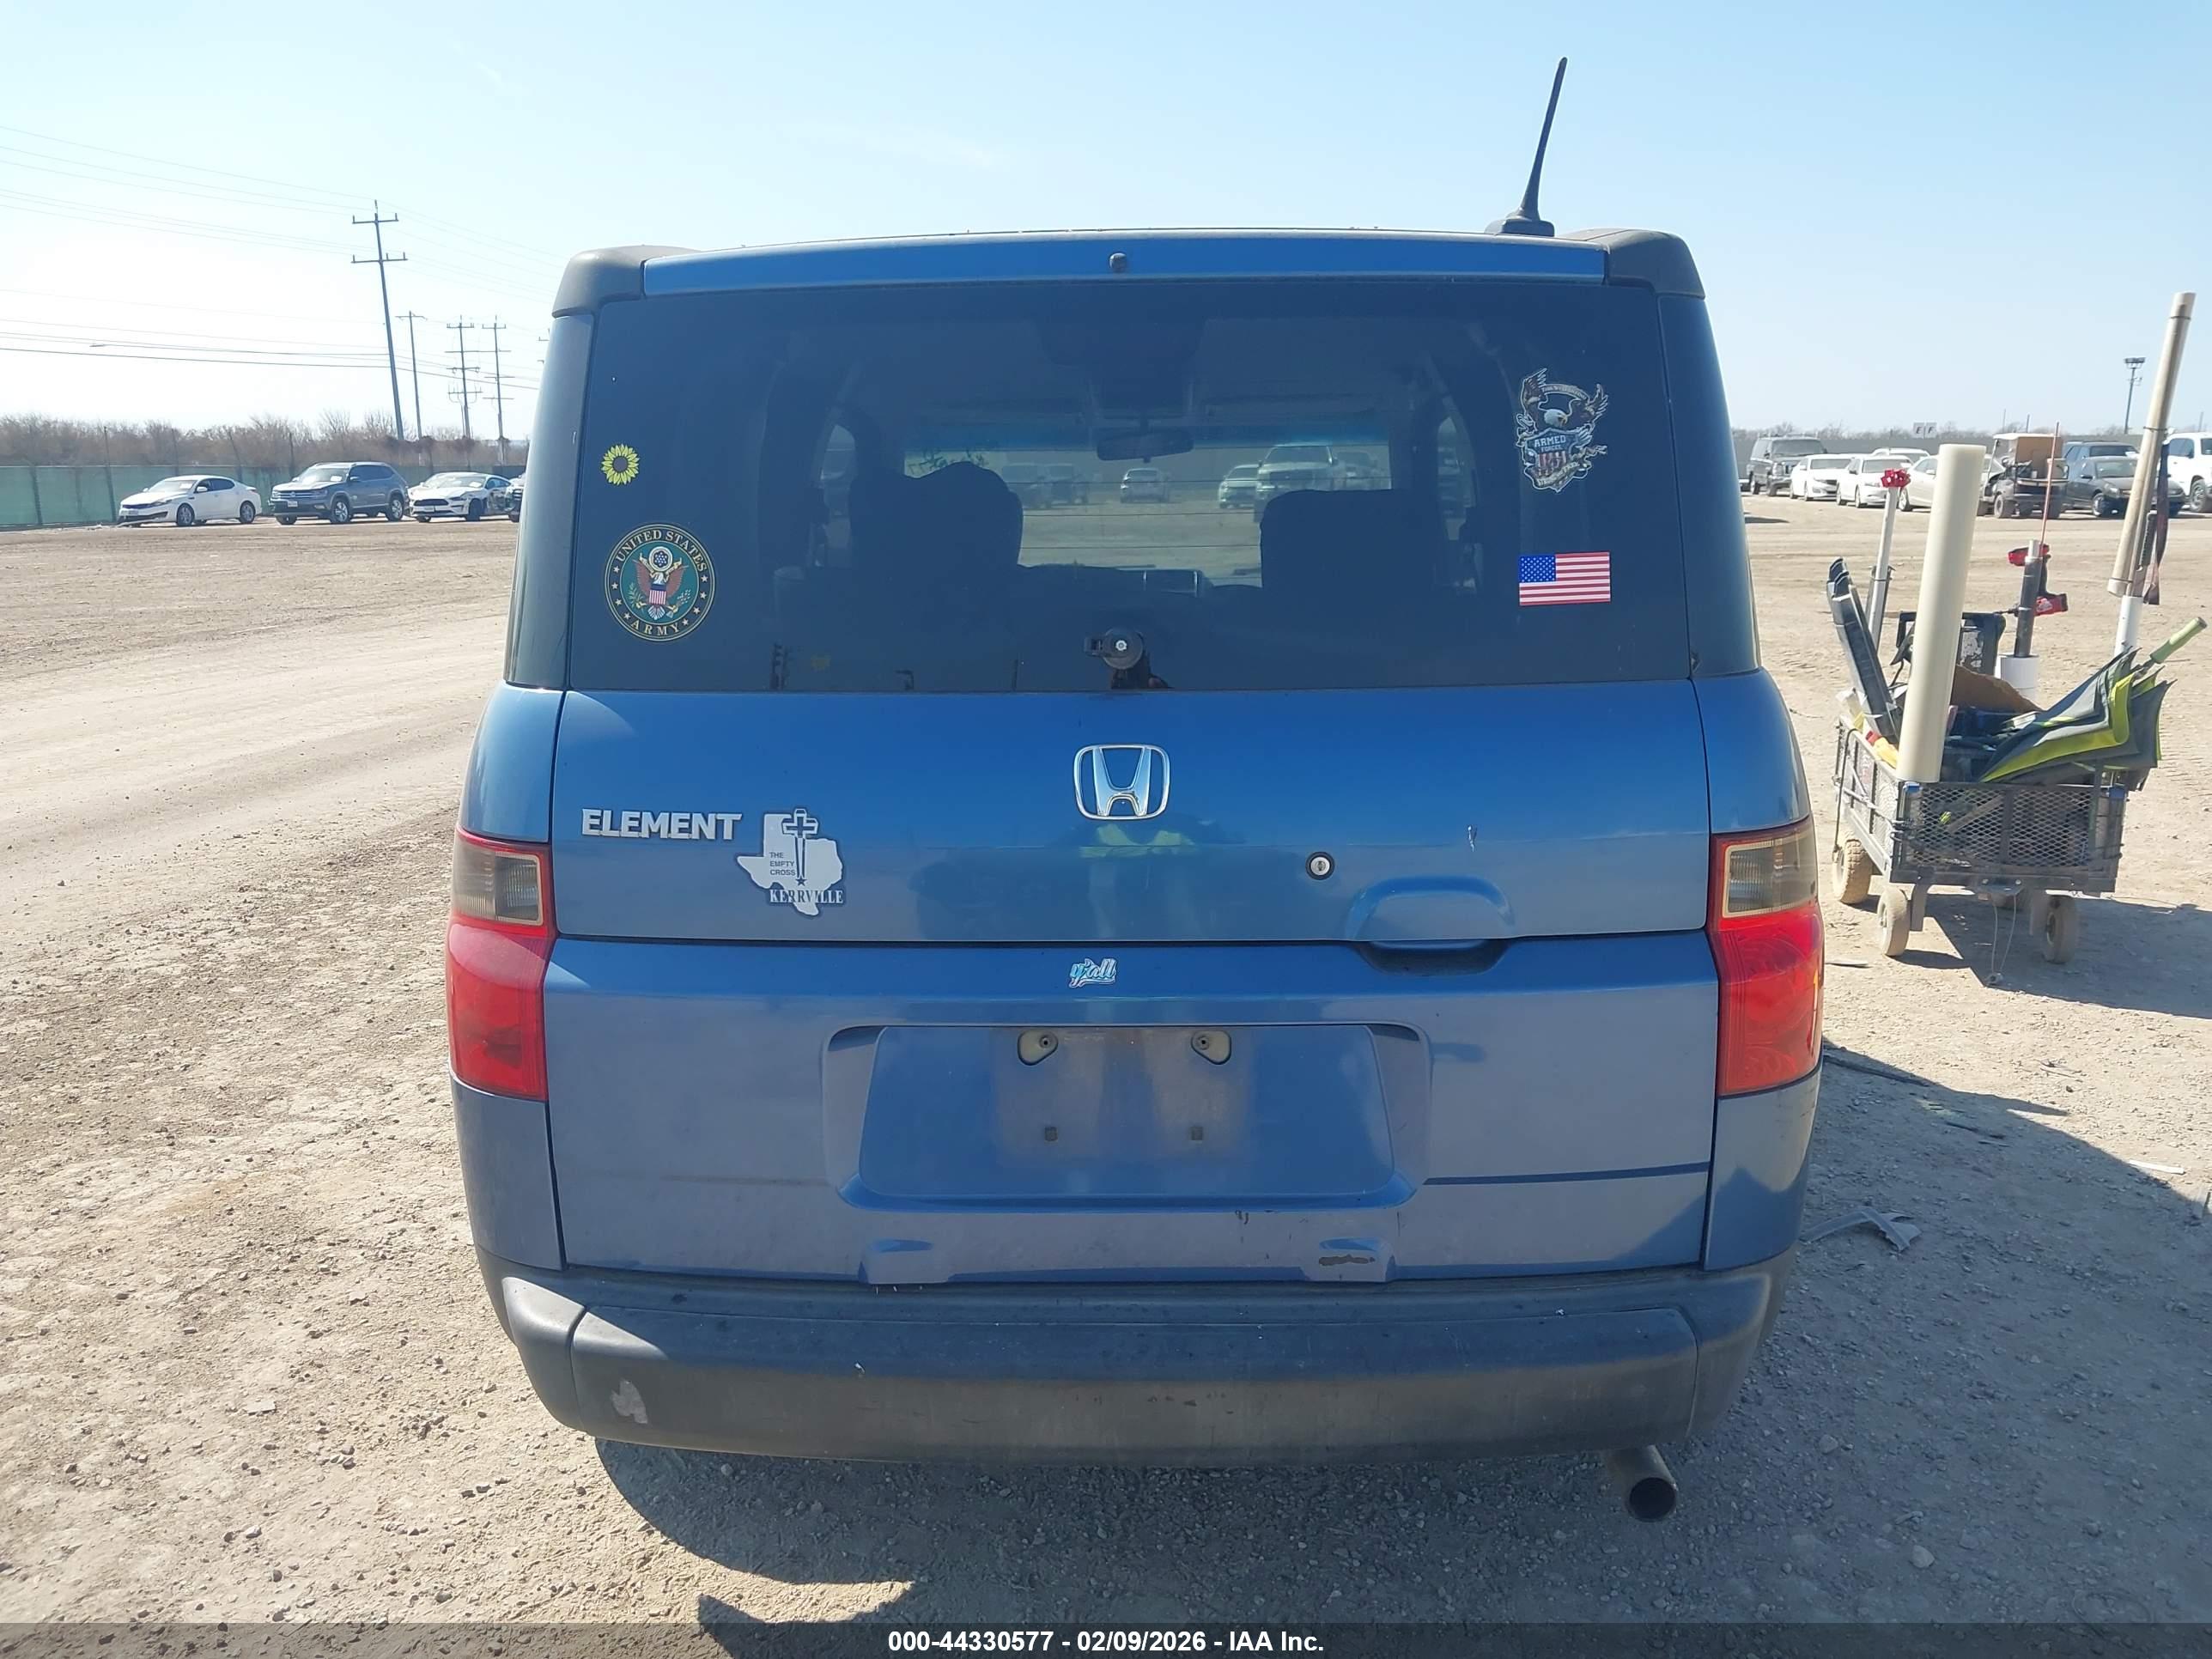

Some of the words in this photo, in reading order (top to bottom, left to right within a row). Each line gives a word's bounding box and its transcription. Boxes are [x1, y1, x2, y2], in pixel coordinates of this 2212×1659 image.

[1534, 434, 1566, 447] ARMED
[616, 530, 662, 563] UNITED
[665, 531, 708, 572] STATES
[631, 619, 681, 636] ARMY
[582, 808, 743, 841] ELEMENT
[769, 889, 843, 904] KERRVILLE
